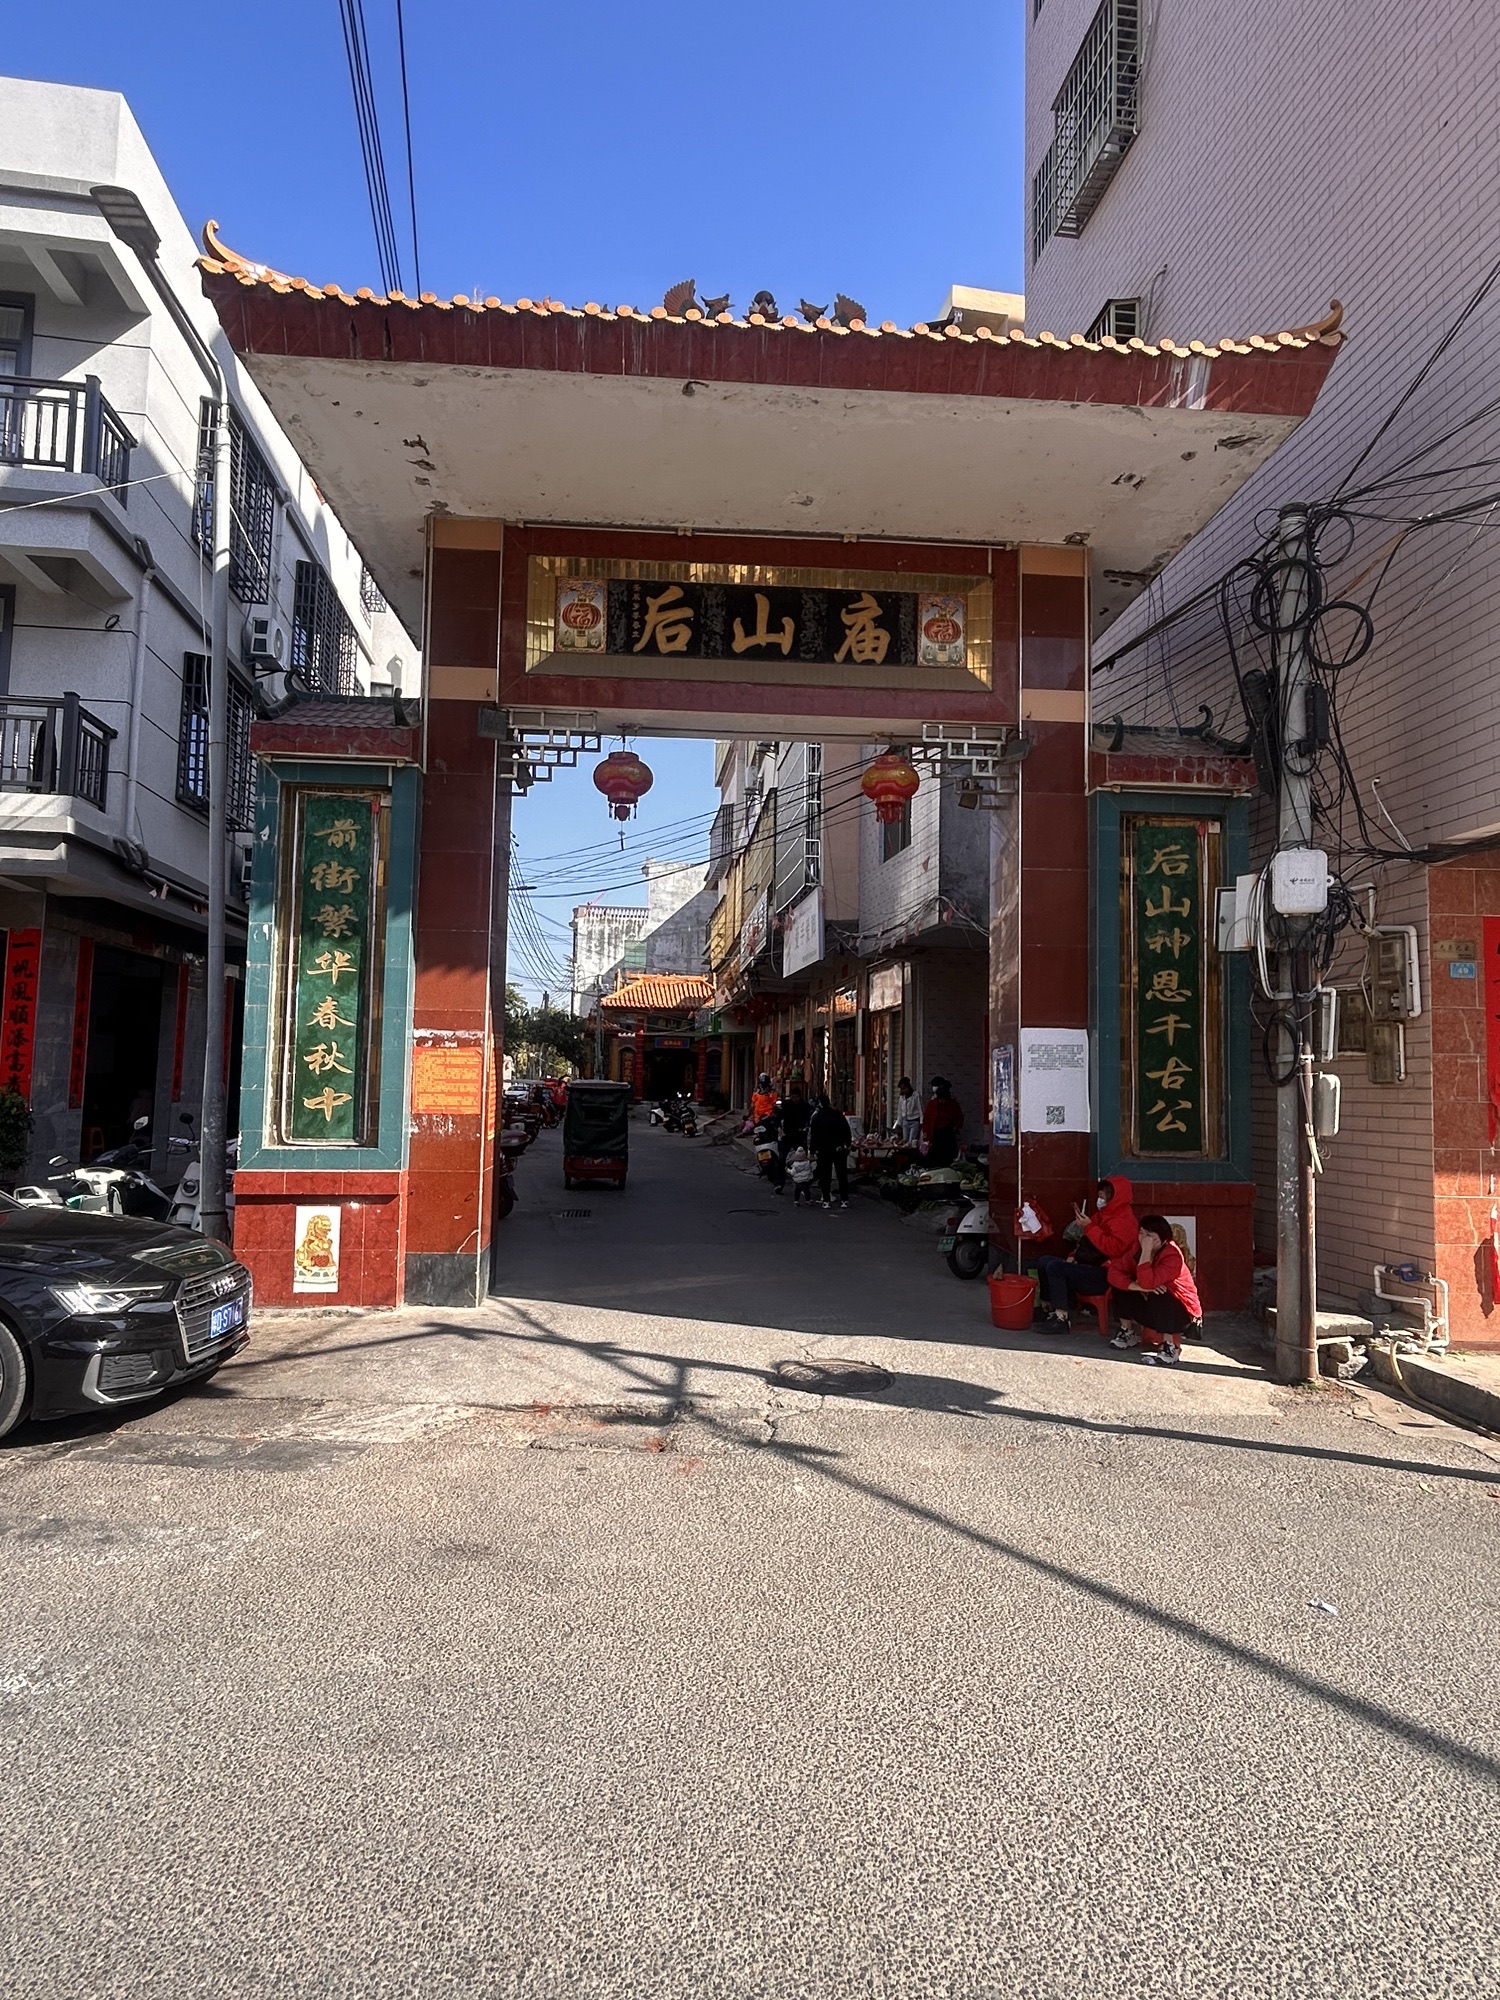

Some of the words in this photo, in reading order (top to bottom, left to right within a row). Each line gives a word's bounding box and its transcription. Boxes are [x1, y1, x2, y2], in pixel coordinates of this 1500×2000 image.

[632, 585, 892, 665] 后山庙
[302, 819, 362, 1122] 前街繁华春秋中
[1145, 845, 1193, 1133] 后山神恩千古公
